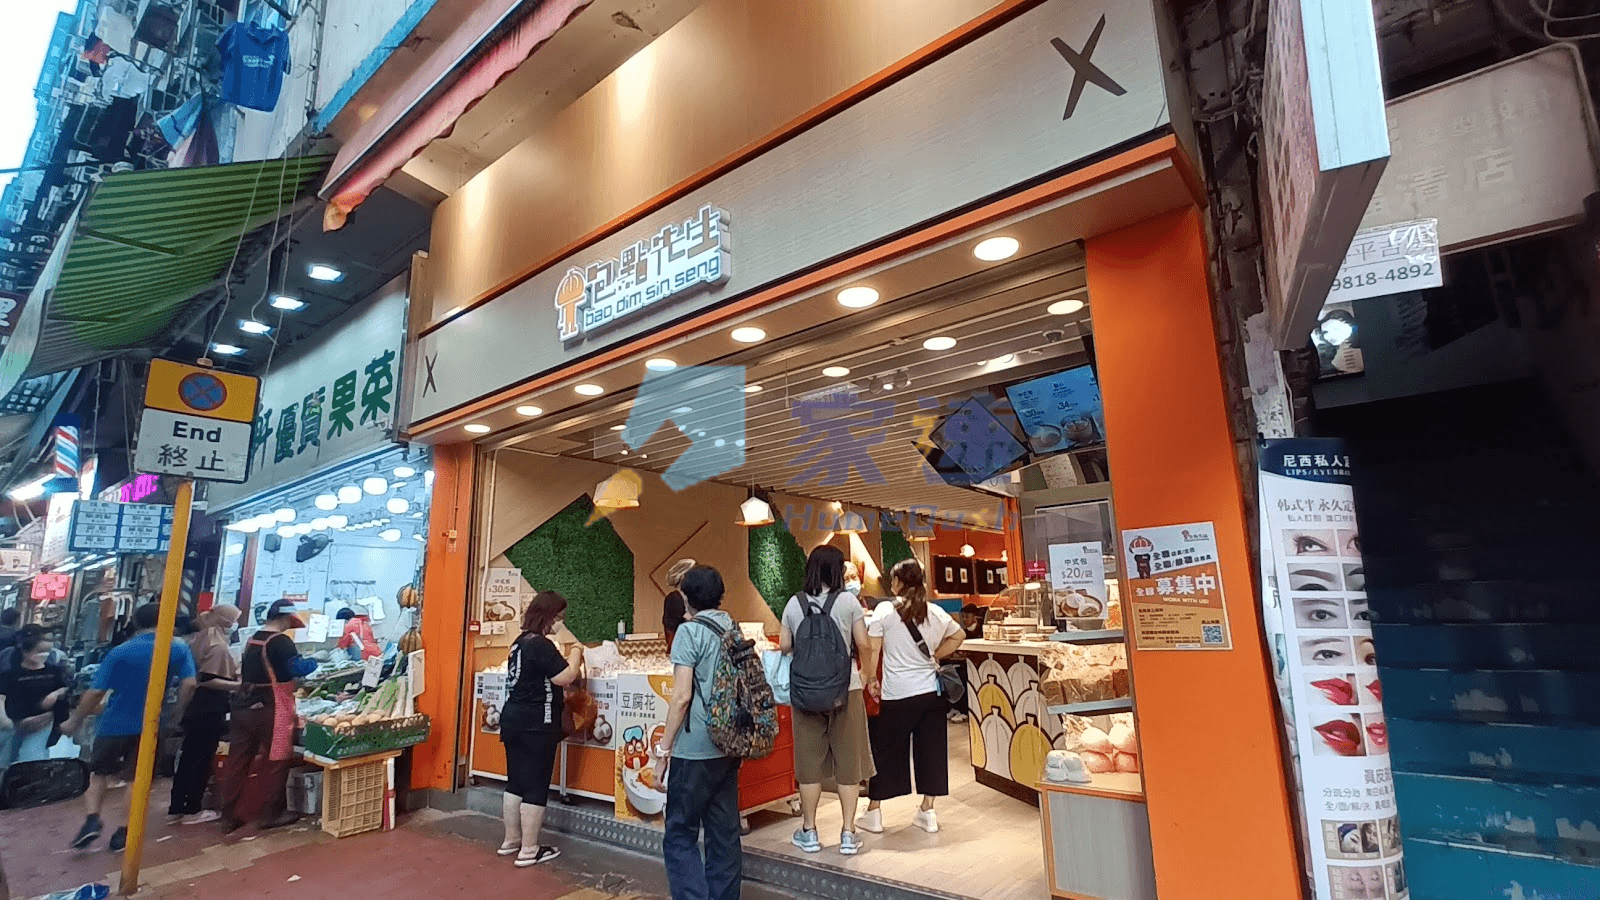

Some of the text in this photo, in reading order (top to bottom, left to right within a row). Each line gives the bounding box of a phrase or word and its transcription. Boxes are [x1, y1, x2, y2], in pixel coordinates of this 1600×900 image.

[586, 204, 720, 303] 包點先生
[1331, 262, 1435, 291] 9818-4892
[585, 256, 720, 327] bao dim sin seng
[172, 420, 222, 443] End
[157, 443, 225, 472] 終止
[1155, 572, 1216, 596] 募集中
[621, 692, 656, 710] 豆腐花
